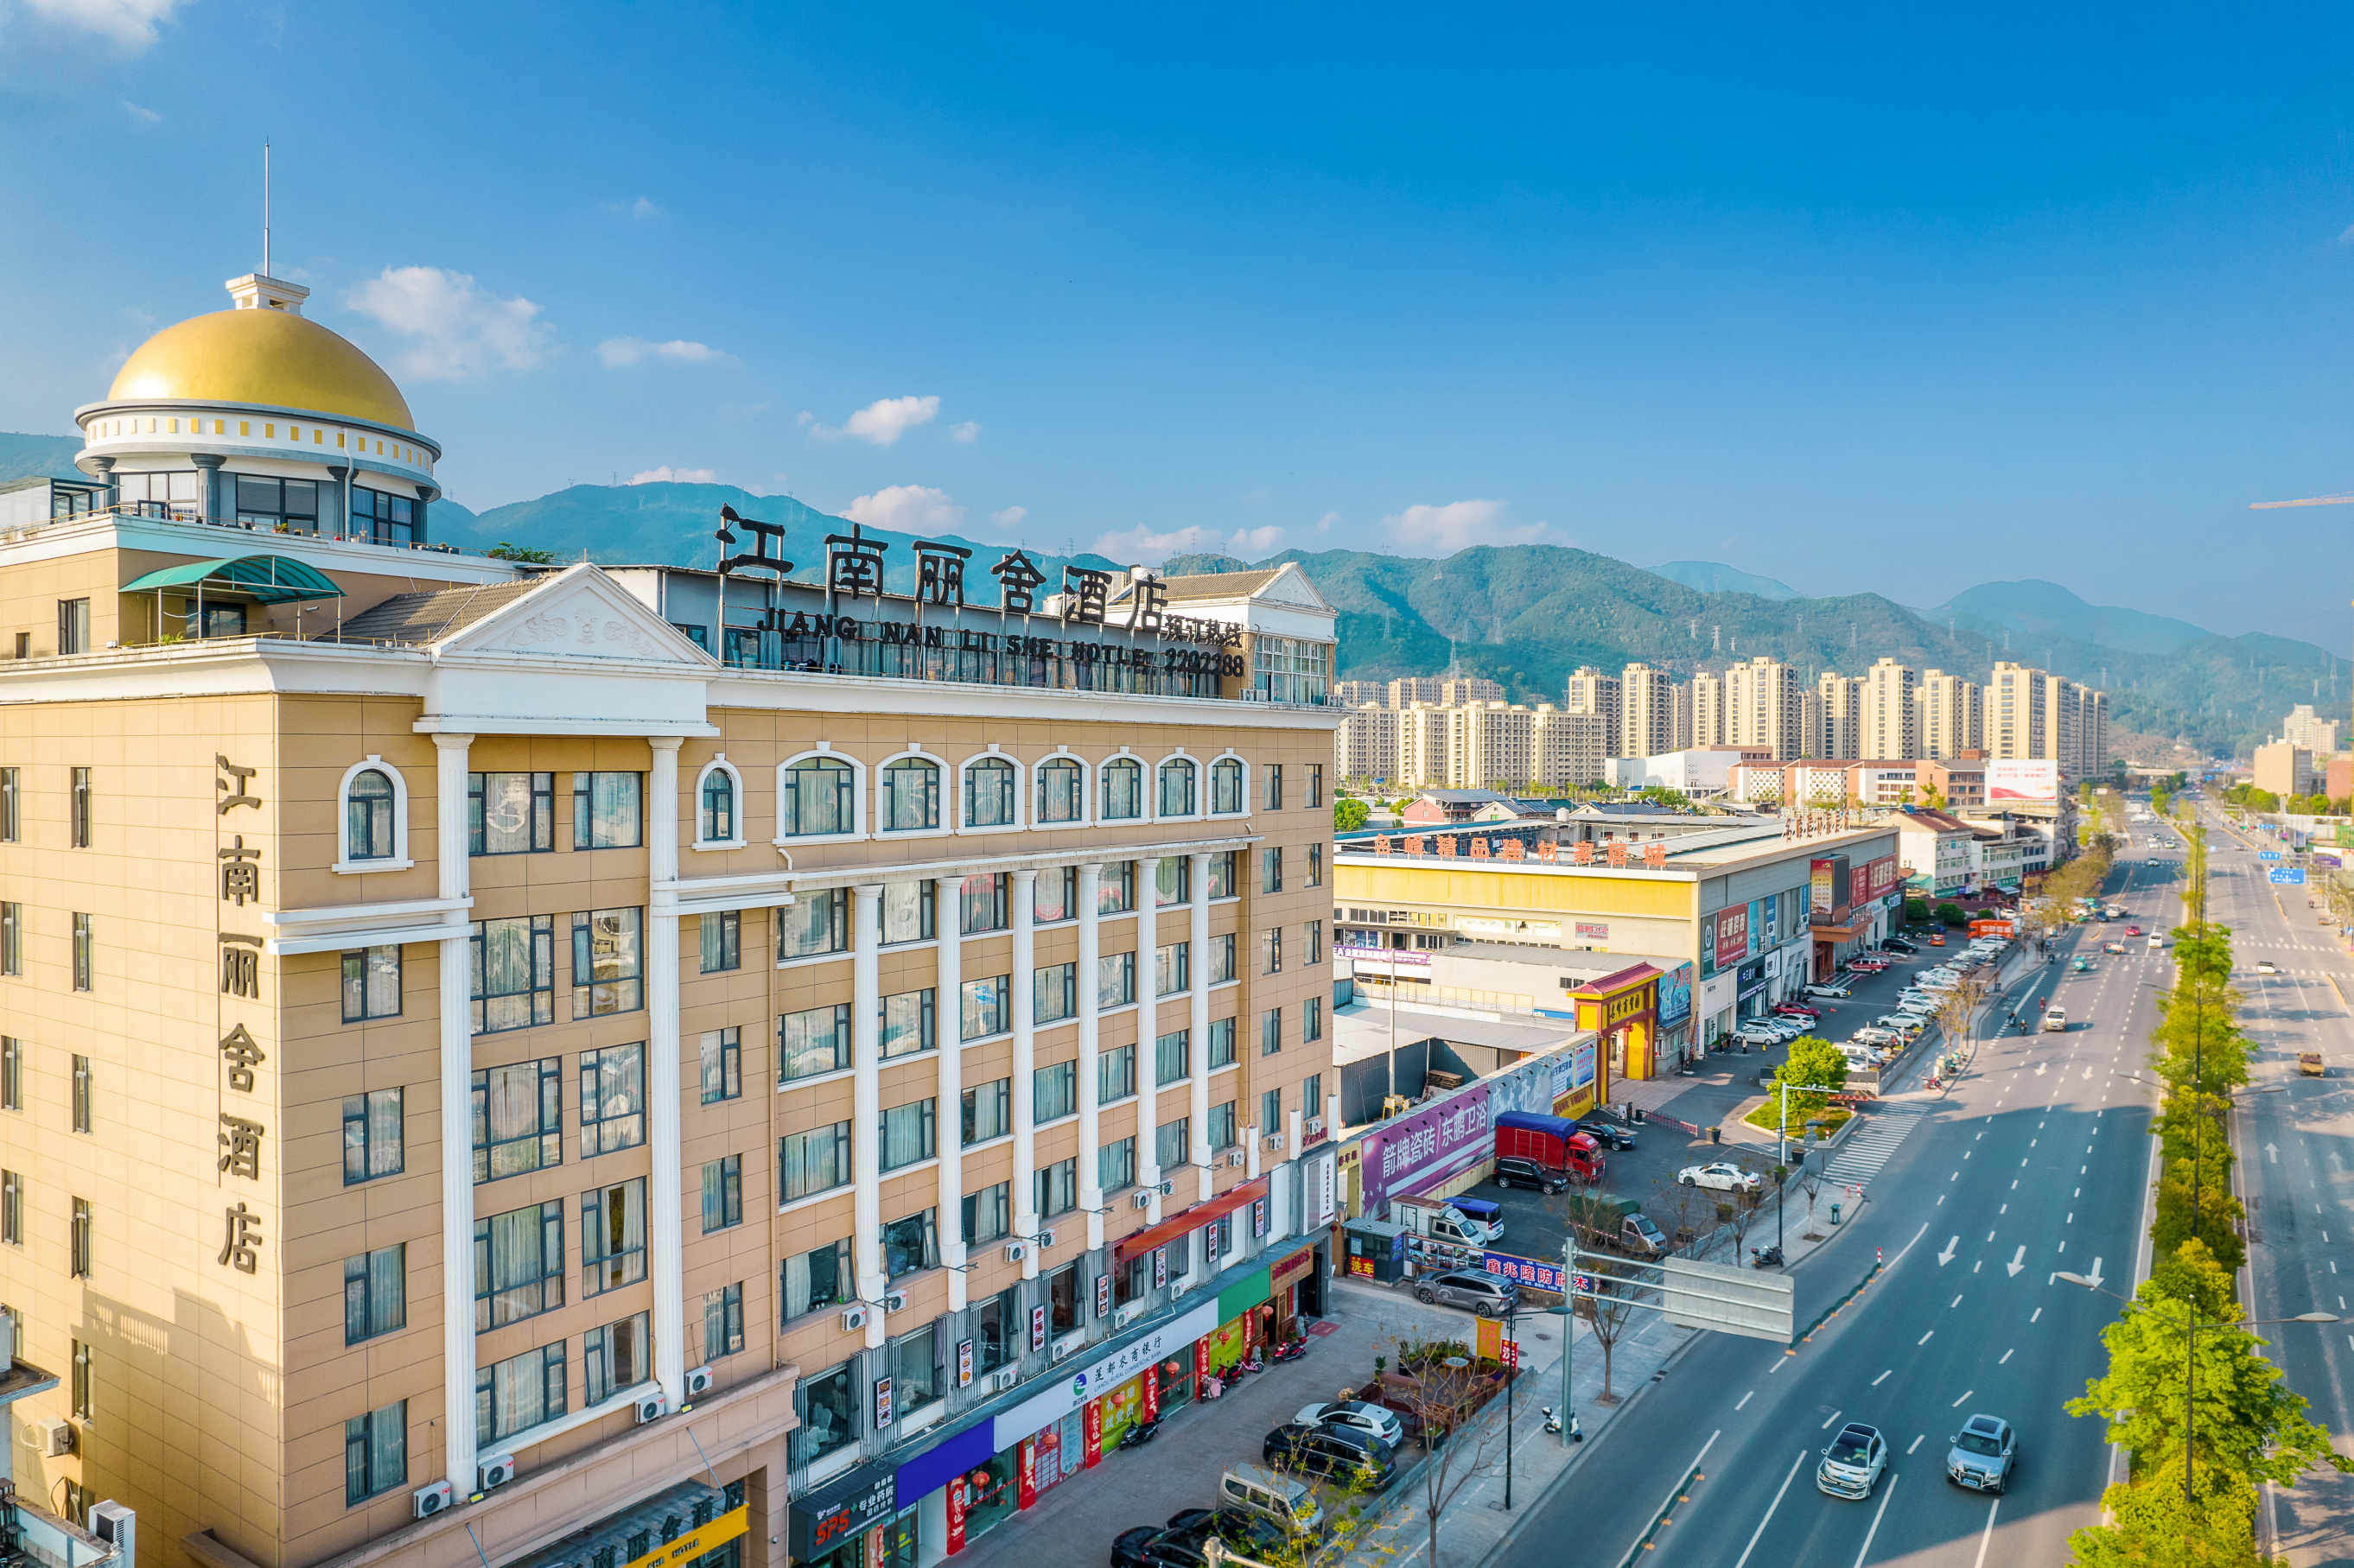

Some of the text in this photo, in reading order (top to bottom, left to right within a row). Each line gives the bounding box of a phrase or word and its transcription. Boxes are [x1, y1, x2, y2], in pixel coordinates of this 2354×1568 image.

[715, 502, 1168, 633] 江南丽舍酒店
[757, 607, 1147, 666] JIANG NAN LI SHE HOTLE
[1164, 614, 1243, 648] 预订热线
[1165, 647, 1244, 678] 2222288
[1374, 834, 1667, 867] 名峰精品建材家居城
[216, 753, 265, 1275] 江南丽舍酒店
[1351, 1260, 1374, 1275] 洗车
[1094, 1350, 1162, 1392] LIANDU RURAL COMMERCIAL BANK
[1095, 1336, 1161, 1382] 莲都农商银行
[1106, 1385, 1136, 1412] 有难
[858, 1485, 894, 1511] 专业药房
[815, 1508, 849, 1546] SPS
[671, 1539, 699, 1558] HOTLE
